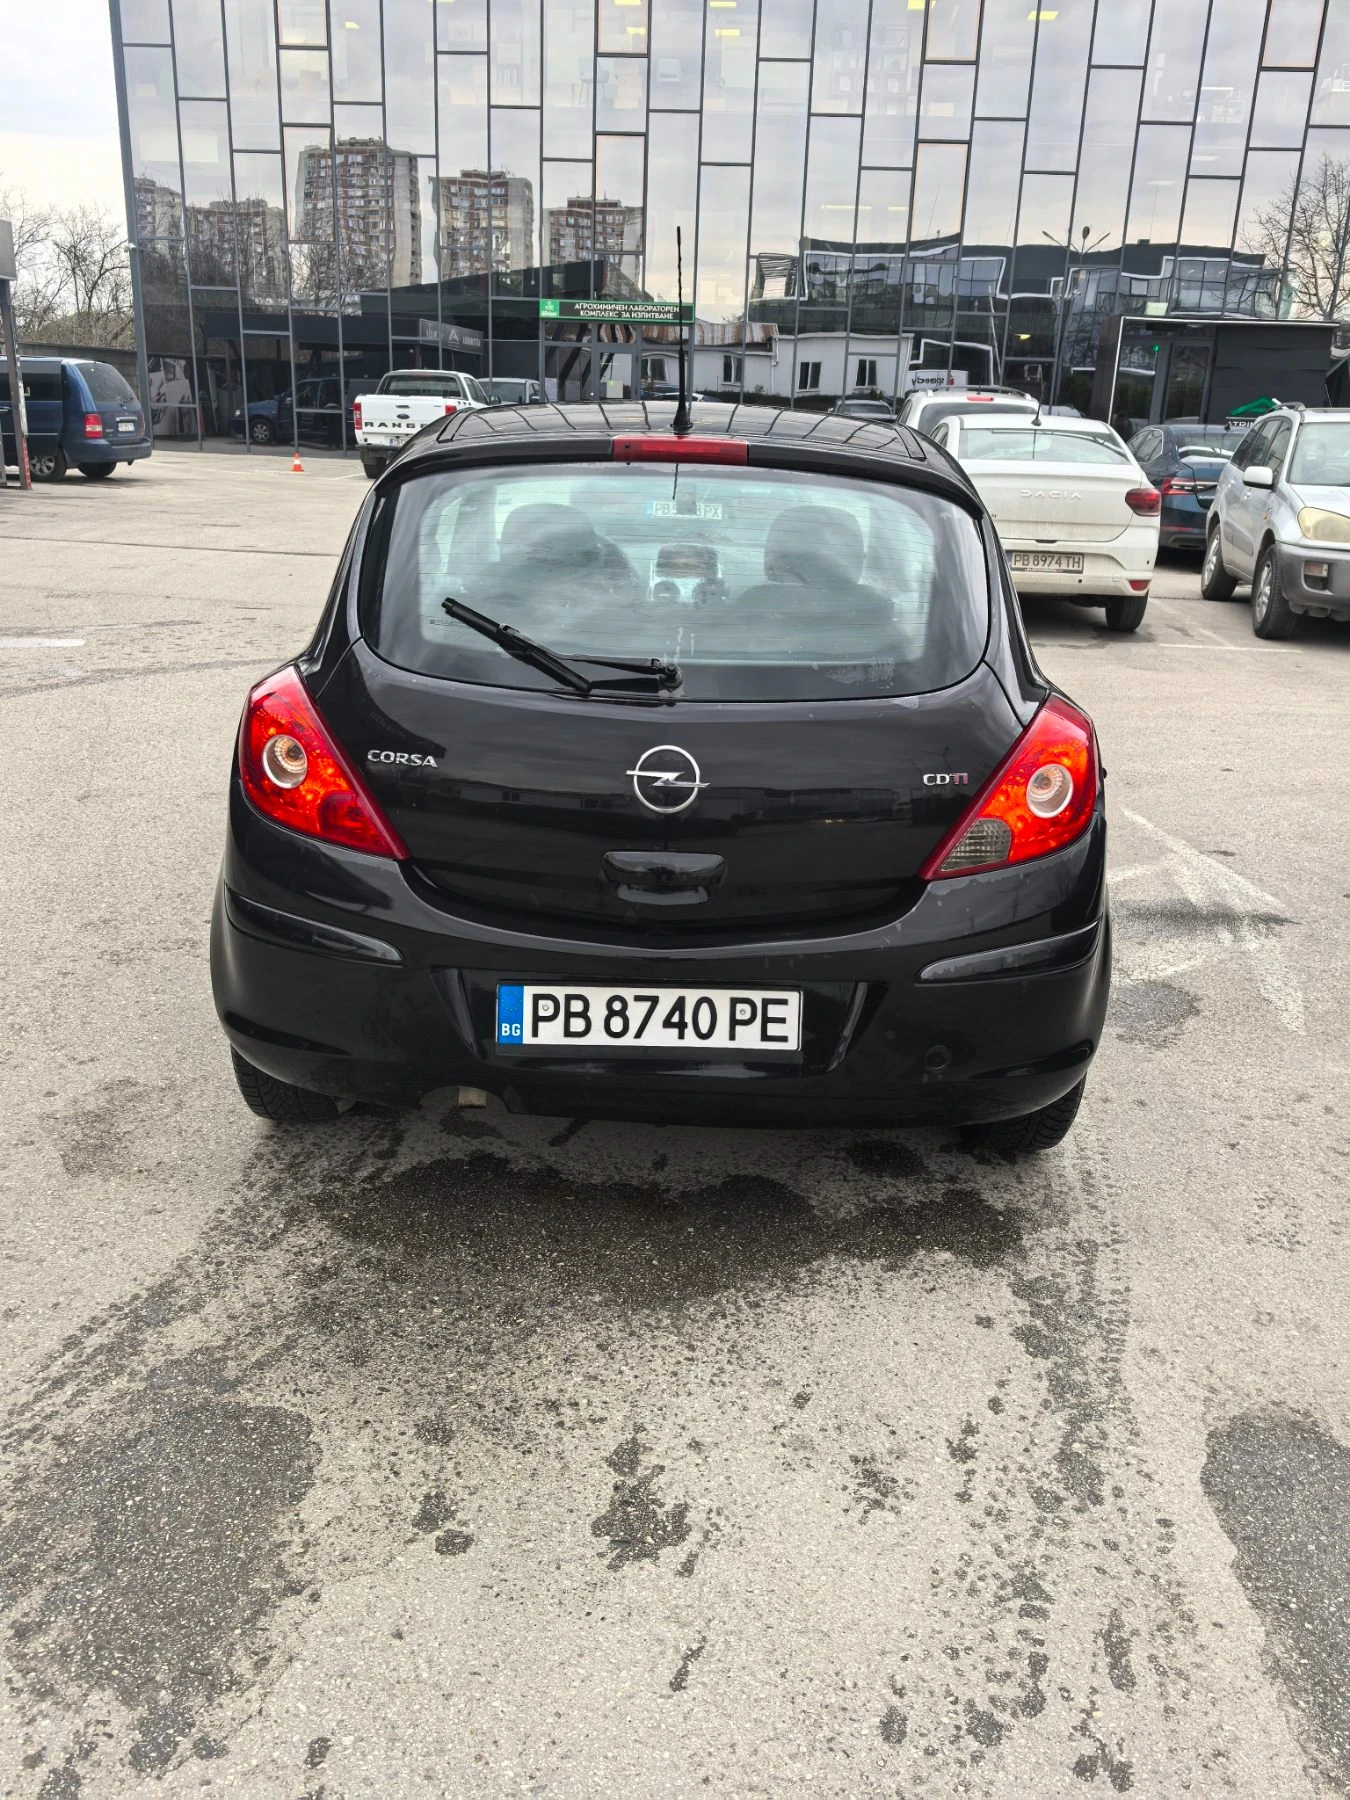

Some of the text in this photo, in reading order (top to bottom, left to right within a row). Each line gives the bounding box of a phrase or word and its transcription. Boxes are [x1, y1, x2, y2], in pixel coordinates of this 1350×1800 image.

[574, 303, 680, 313] АГРОХИМИЧЕН ЛАБОРАТОРЕН
[580, 310, 619, 318] КОМПЛЕКС
[1020, 490, 1082, 500] DACIA
[1013, 554, 1081, 569] PB 8974 TH
[367, 749, 438, 768] CORSA
[922, 772, 969, 786] CDTI
[531, 993, 789, 1042] PB 8740 PE
[501, 1023, 521, 1037] BG
